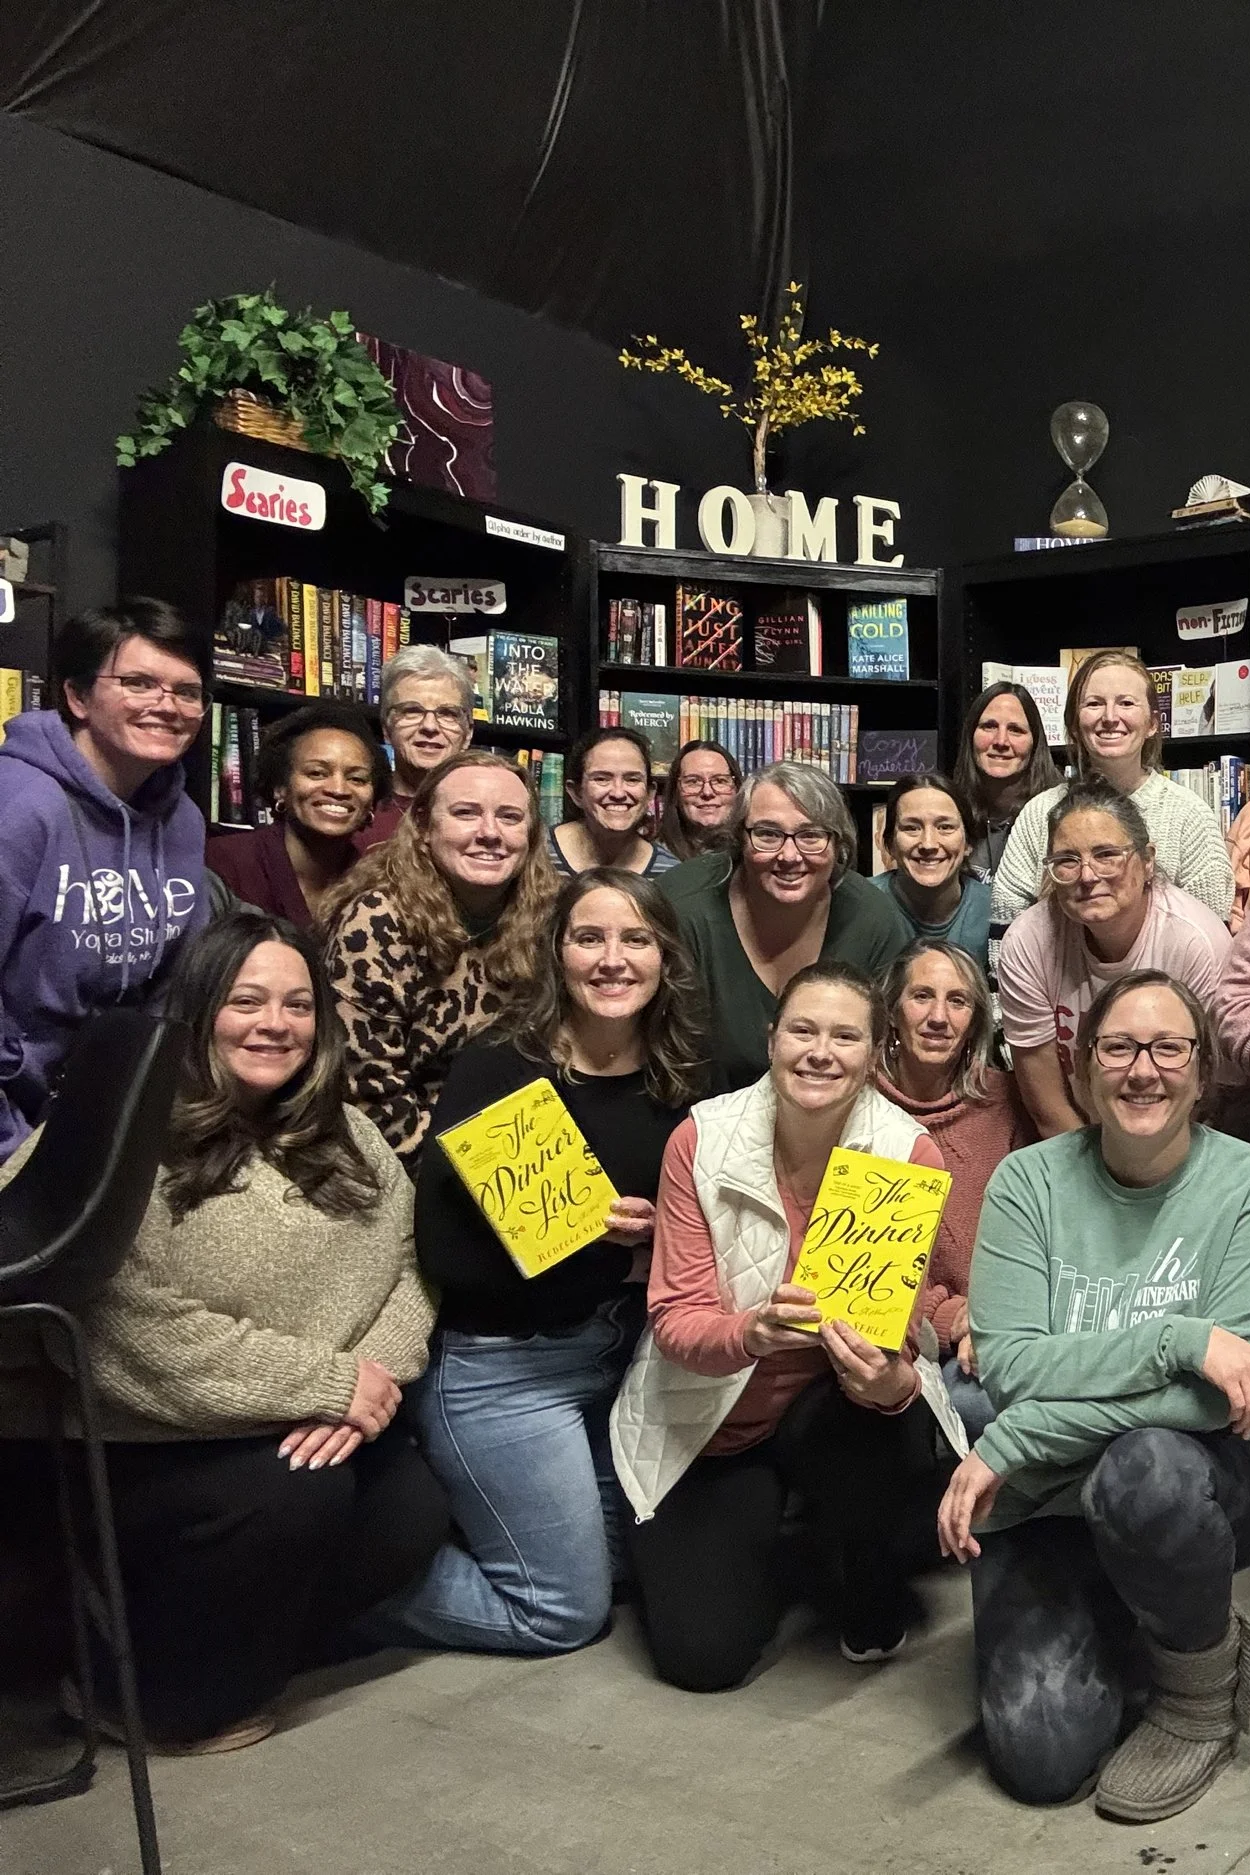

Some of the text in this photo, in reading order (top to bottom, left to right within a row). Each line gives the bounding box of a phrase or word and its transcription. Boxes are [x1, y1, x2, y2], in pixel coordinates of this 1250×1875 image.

[226, 468, 312, 526] Scaries
[616, 473, 905, 568] HOME
[291, 591, 299, 612] DAVID
[411, 582, 496, 606] Scaries
[685, 593, 740, 616] KING
[323, 602, 331, 623] DAVID
[341, 604, 350, 628] DAVID
[758, 615, 804, 624] GILLIAN
[861, 603, 903, 619] KILLING
[291, 614, 300, 649] BALDACCI
[323, 625, 332, 659] BALDACCI
[400, 617, 410, 644] DAVID
[851, 623, 904, 638] COLD
[343, 630, 351, 668] BALDACCI
[503, 643, 545, 660] INTO
[852, 654, 904, 663] KATE ALICE
[507, 662, 541, 677] THE
[852, 664, 904, 673] MARSHALL
[496, 677, 557, 698] WATER
[1029, 685, 1061, 695] aven't
[505, 702, 544, 716] PAULA
[628, 709, 674, 720] Redeemed by
[496, 715, 554, 730] HAWKINS
[634, 719, 669, 727] MERCY
[486, 1108, 543, 1160] The
[475, 1124, 579, 1221] Dinner
[519, 1168, 591, 1240] List
[863, 1172, 915, 1214] The
[805, 1206, 938, 1254] Dinner
[1145, 1237, 1198, 1283] the
[817, 1252, 901, 1301] List
